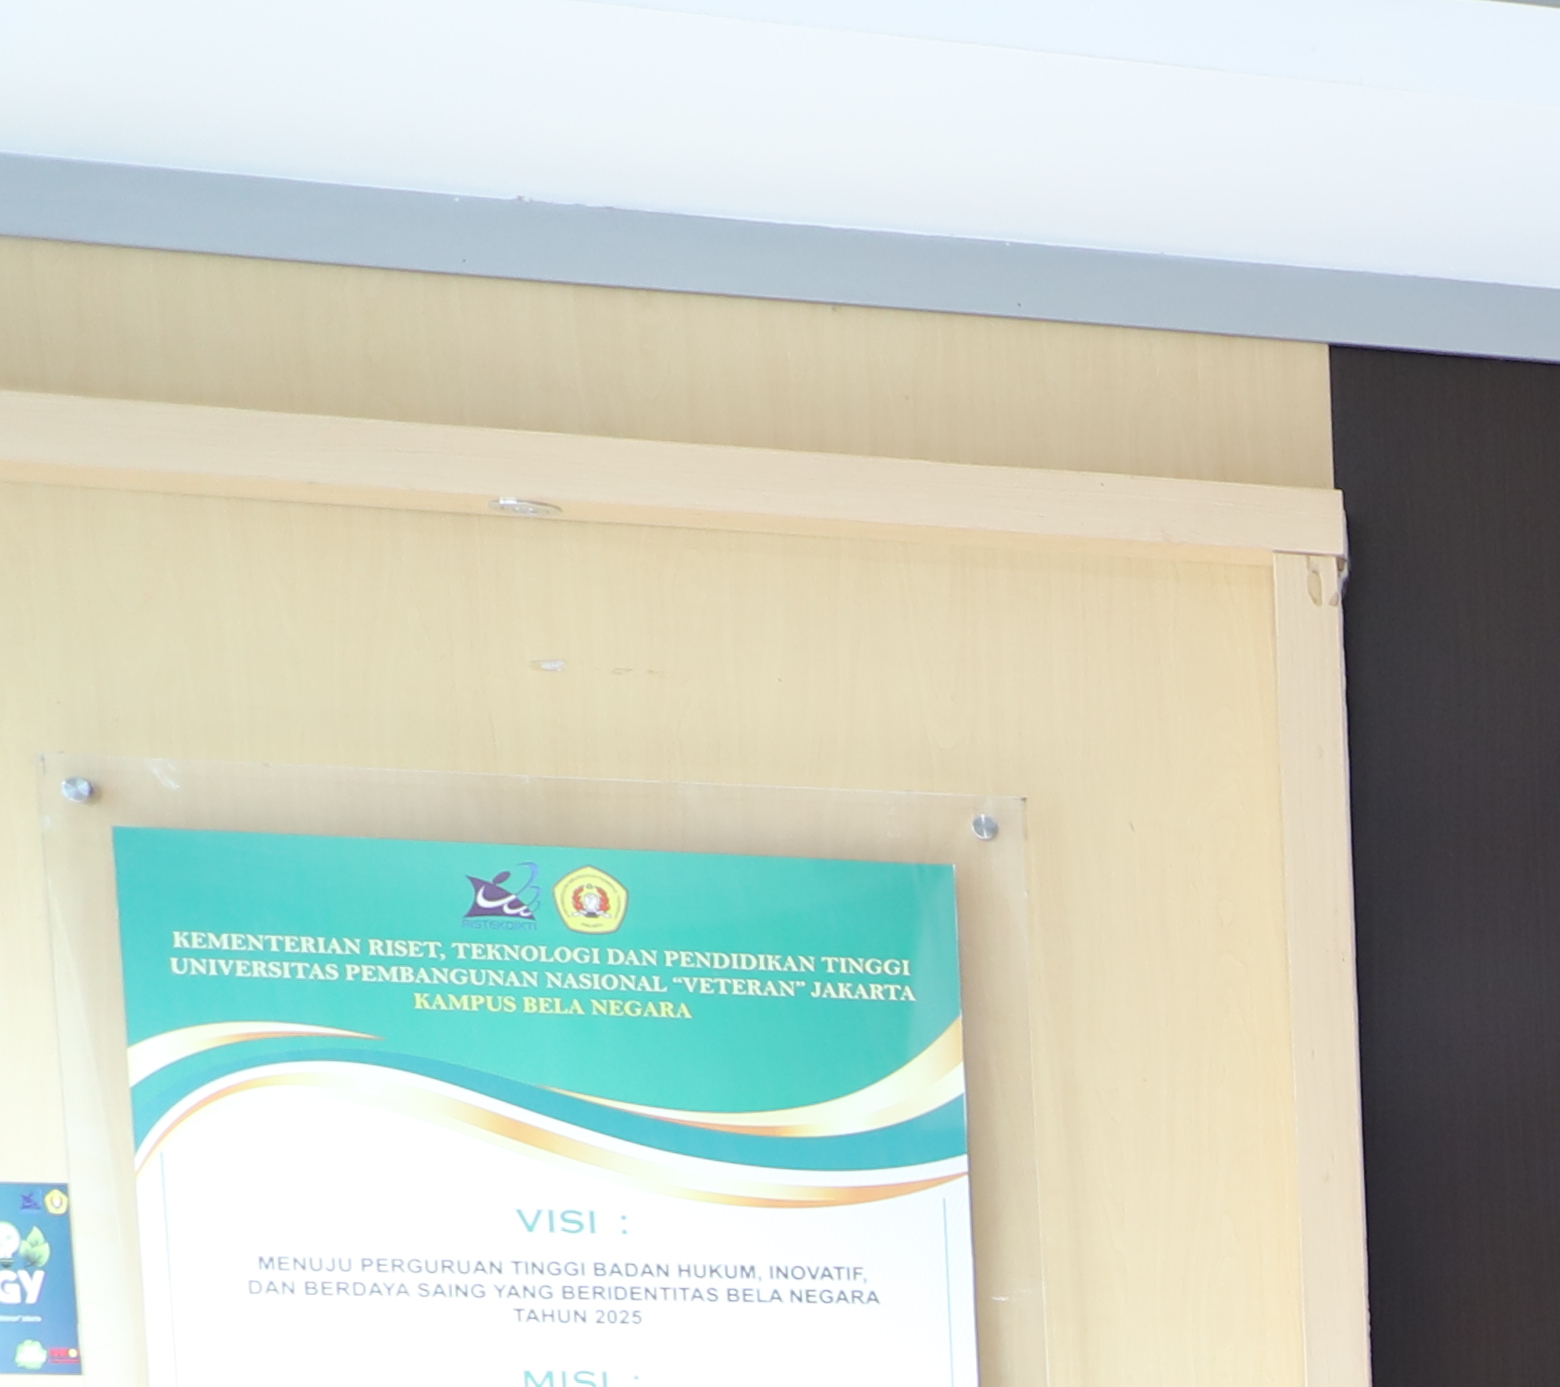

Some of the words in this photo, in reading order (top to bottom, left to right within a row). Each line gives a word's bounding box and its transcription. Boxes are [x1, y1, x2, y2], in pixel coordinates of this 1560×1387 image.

[172, 931, 361, 956] KEMENTERIAN
[369, 938, 447, 961] RISET,
[451, 941, 601, 965] TEKNOLOGI
[607, 948, 658, 967] DAN
[664, 950, 815, 973] PENDIDIKAN
[821, 955, 911, 976] TINGGI
[170, 957, 339, 981] UNIVERSITAS
[345, 964, 538, 989] PEMBANGUNAN
[546, 972, 668, 994] NASIONAL
[810, 982, 916, 1002] JAKARTA
[414, 993, 517, 1013] KAMPUS
[523, 996, 585, 1016] BELA
[591, 999, 692, 1019] NEGARA
[515, 1208, 597, 1234] VISI
[258, 1256, 352, 1273] MENUJU
[360, 1258, 503, 1275] PERGURUAN
[511, 1260, 586, 1276] TINGGI
[593, 1262, 670, 1278] BADAN
[677, 1263, 762, 1282] HUKUM,
[769, 1265, 868, 1284] INOVATIF,
[248, 1280, 295, 1295] DAN
[304, 1281, 411, 1297] BERDAYA
[417, 1283, 486, 1299] SAING
[494, 1284, 554, 1300] YANG
[561, 1285, 720, 1302] BERIDENTITAS
[727, 1287, 784, 1304] BELA
[790, 1289, 881, 1305] NEGARA
[513, 1308, 587, 1324] TAHUN
[595, 1309, 643, 1325] 2025
